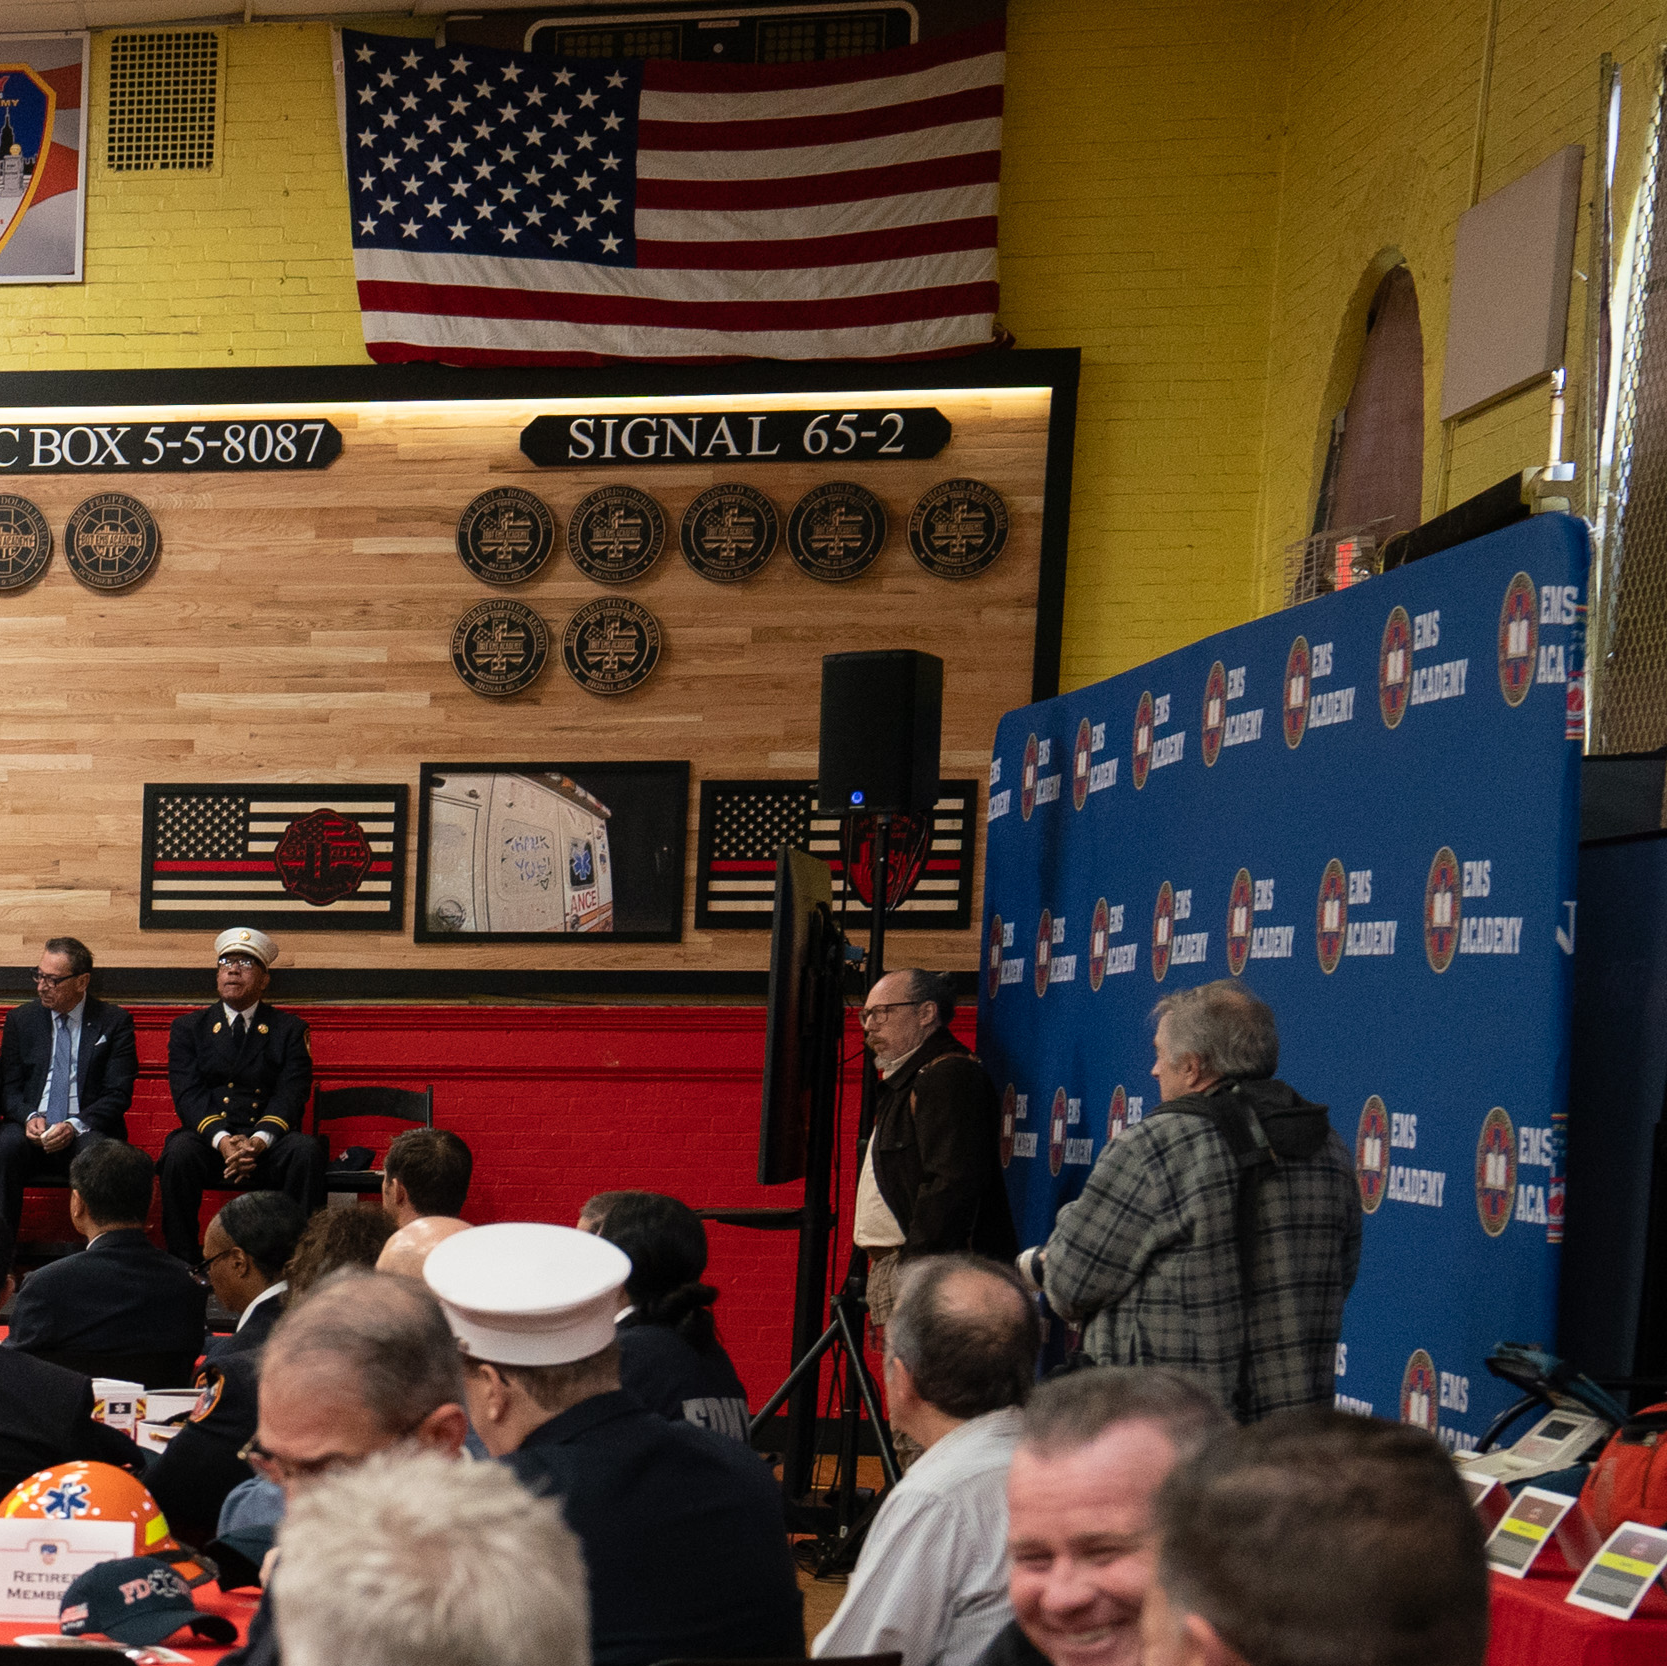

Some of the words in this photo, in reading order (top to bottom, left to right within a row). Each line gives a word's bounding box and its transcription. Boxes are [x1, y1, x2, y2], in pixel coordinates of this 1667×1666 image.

[28, 425, 131, 466] BOX
[141, 422, 326, 465] 5-5-8087
[568, 415, 780, 459] SIGNAL
[802, 413, 906, 455] 65-2
[1540, 585, 1579, 625] EMS
[1414, 610, 1440, 650] EMS
[1312, 642, 1333, 678] EMS
[1411, 658, 1468, 705] ACADEMY
[1223, 708, 1264, 747] ACADEMY
[1308, 687, 1355, 729] ACADEMY
[1254, 879, 1274, 911] EMS
[1348, 870, 1372, 905] EMS
[1462, 860, 1491, 897] EMS
[1250, 926, 1295, 959] ACADEMY
[1344, 920, 1398, 956] ACADEMY
[1459, 917, 1523, 954] ACADEMY
[1390, 1112, 1417, 1149] EMS
[1518, 1127, 1552, 1167] EMS
[1387, 1165, 1446, 1208] ACADEMY
[1439, 1371, 1469, 1413] EMS
[7, 1588, 69, 1601] MEMBE
